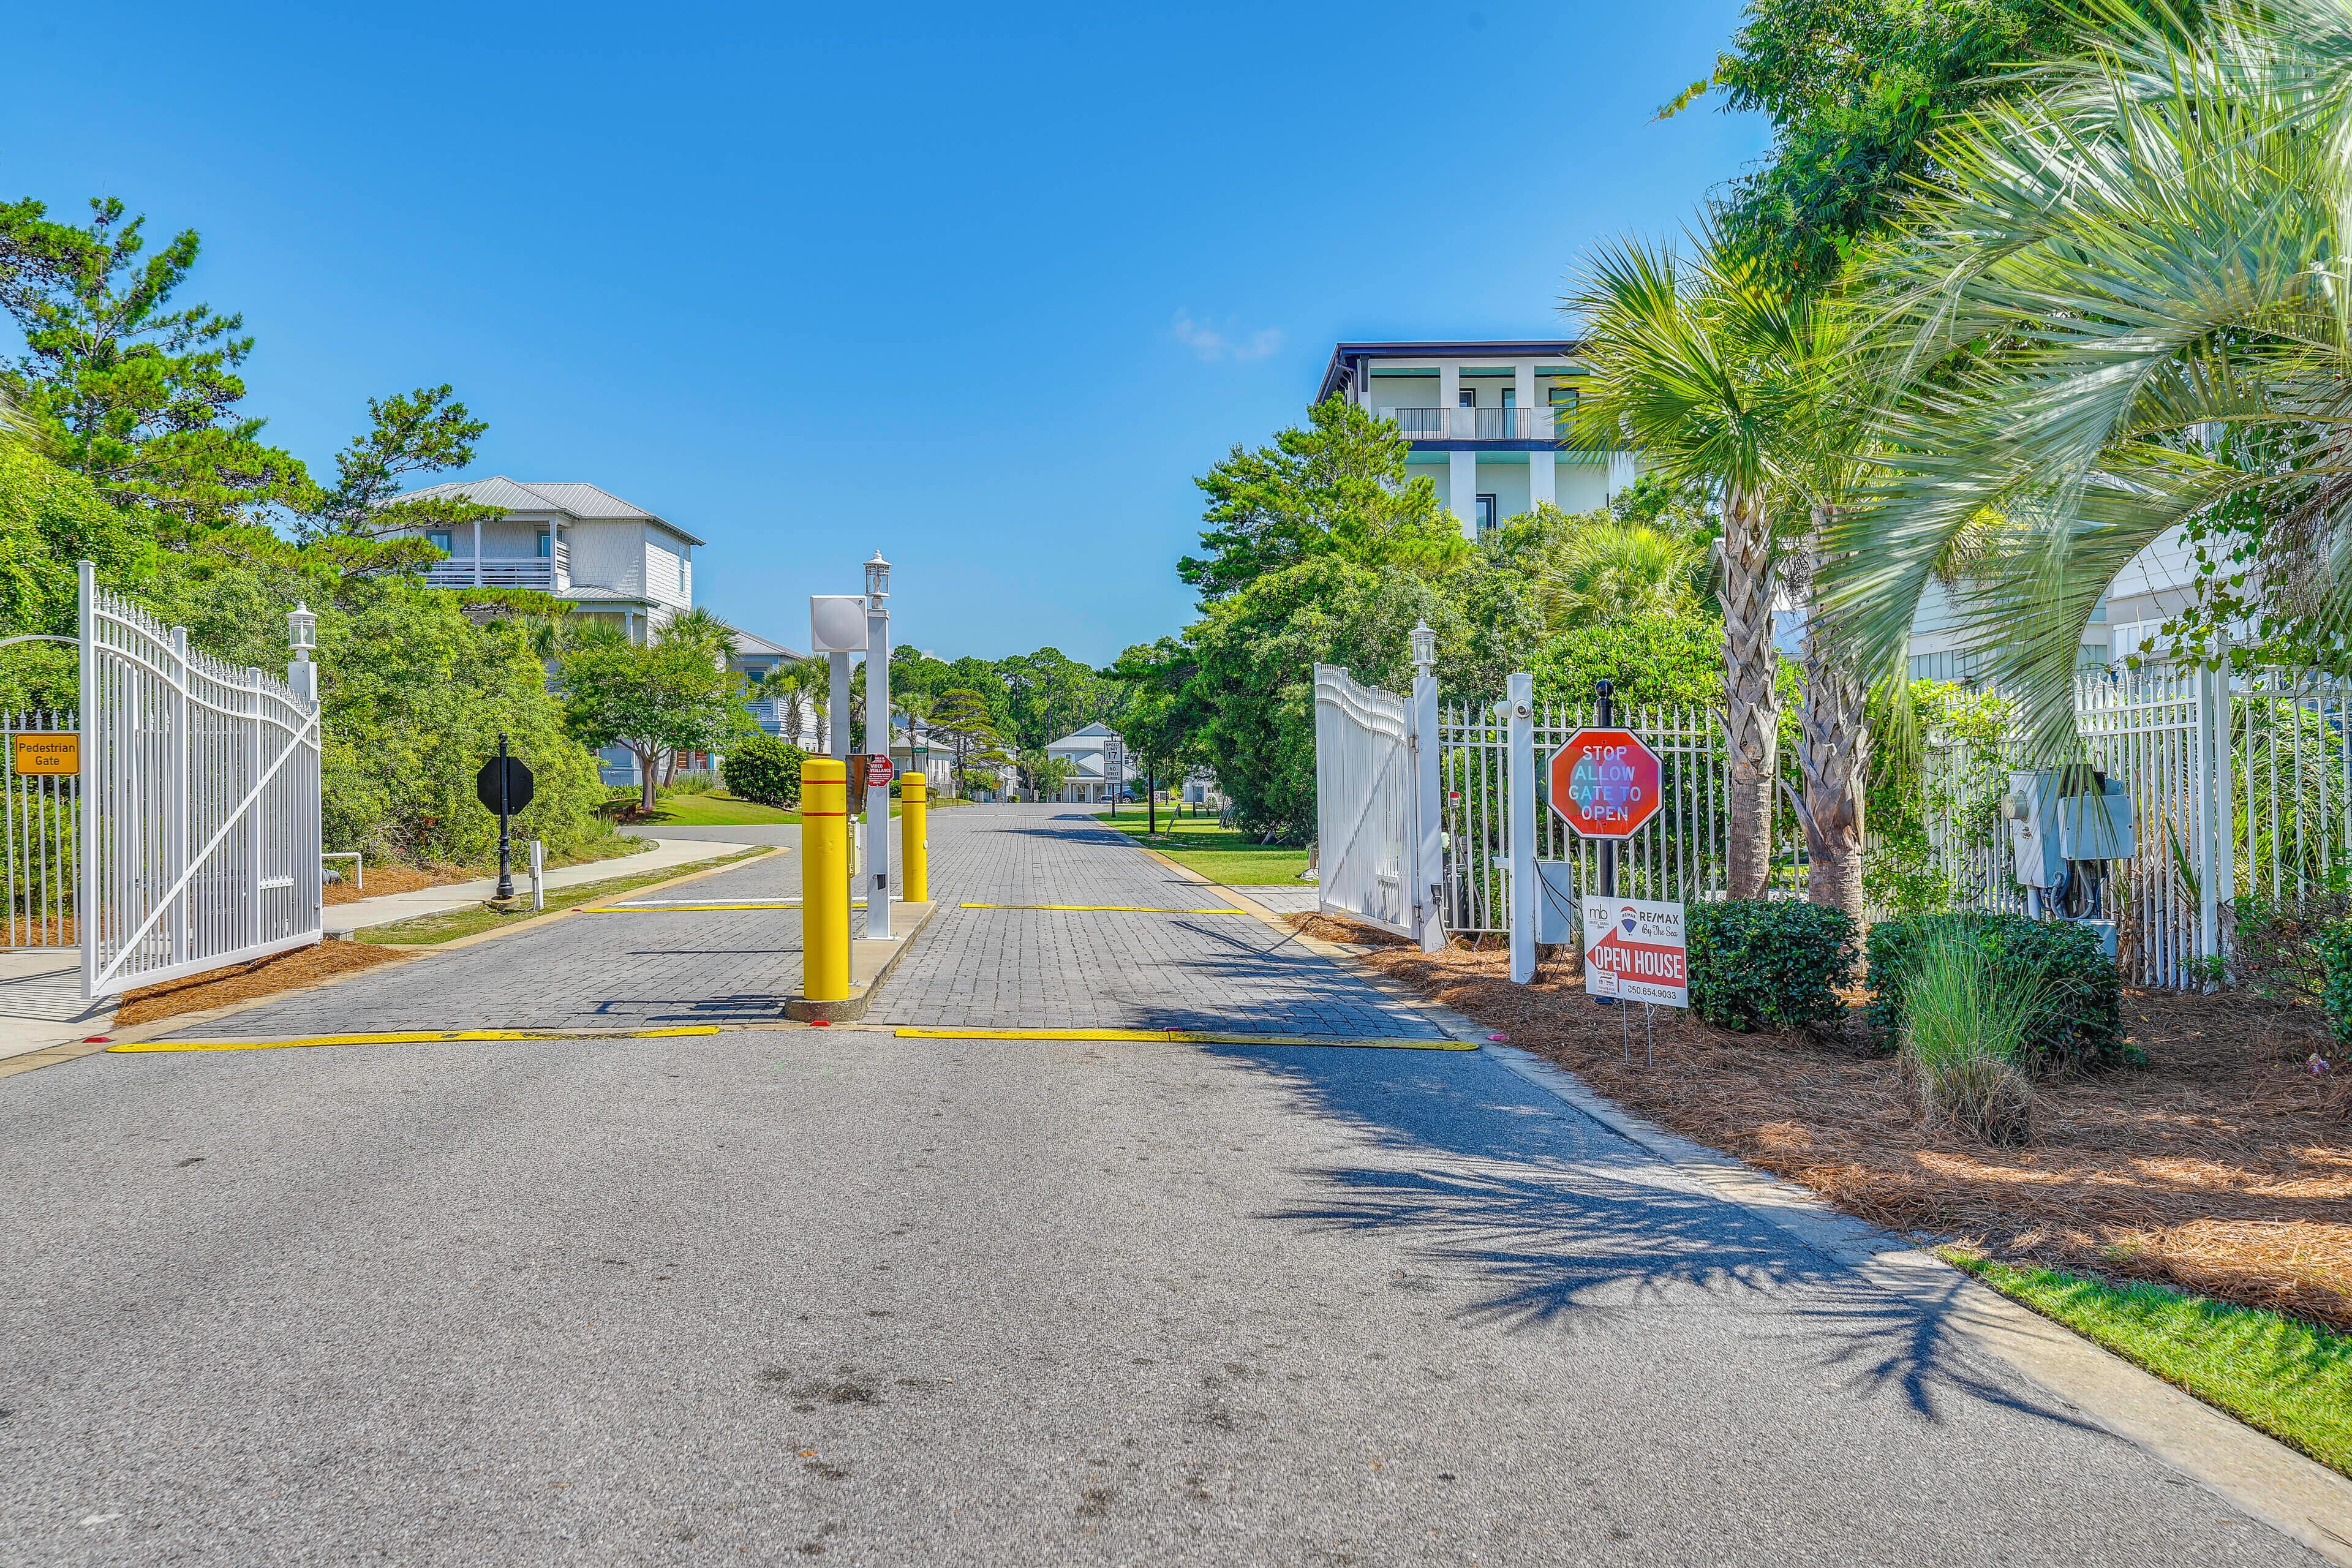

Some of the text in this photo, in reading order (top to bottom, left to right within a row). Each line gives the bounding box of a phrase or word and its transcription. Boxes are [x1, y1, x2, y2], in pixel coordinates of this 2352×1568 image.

[19, 743, 75, 752] Pedestrian
[1582, 745, 1627, 761] STOP
[36, 756, 59, 765] Gate
[1574, 766, 1635, 782] ALLOW
[1569, 785, 1642, 802] GATE TO
[1581, 805, 1629, 821] OPEN
[1589, 903, 1608, 920] mb
[1639, 911, 1679, 925] RE/MAX
[1642, 924, 1678, 937] By The Sea
[1594, 945, 1683, 979] OPEN HOUSE
[1627, 985, 1676, 1000] 850.654.9033
